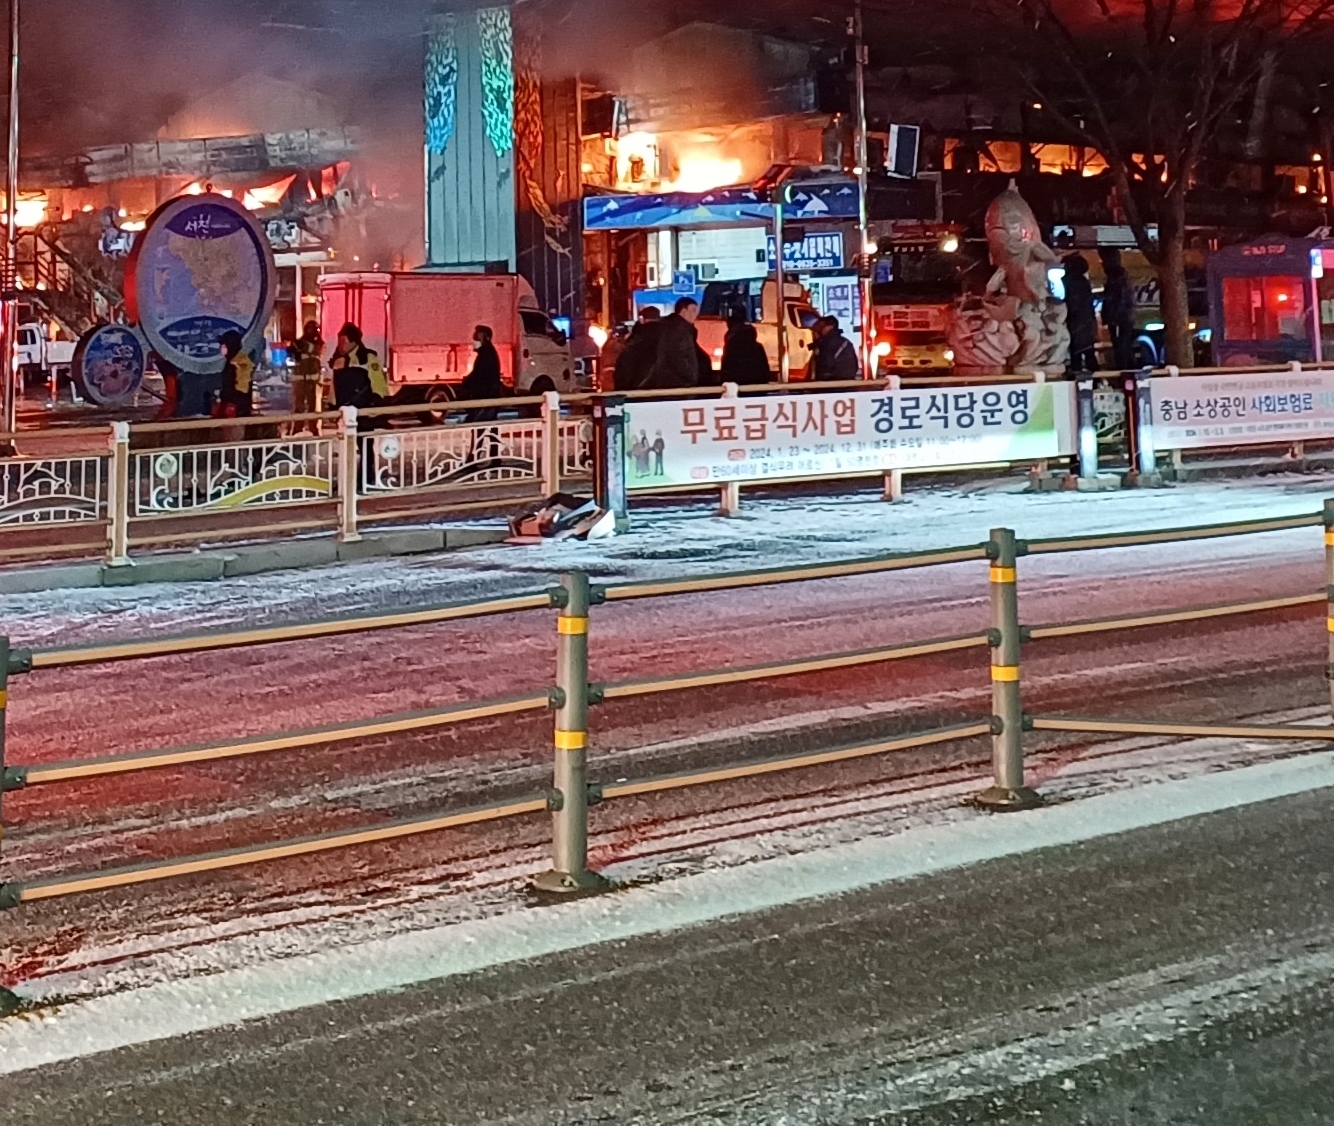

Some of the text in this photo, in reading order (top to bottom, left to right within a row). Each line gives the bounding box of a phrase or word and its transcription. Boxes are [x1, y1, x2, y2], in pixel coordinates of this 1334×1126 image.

[679, 387, 1031, 445] 무료급식사업 경로식당운영
[1159, 397, 1190, 422] 충남
[1192, 395, 1248, 419] 소상공인
[1250, 392, 1315, 415] 사회보험료
